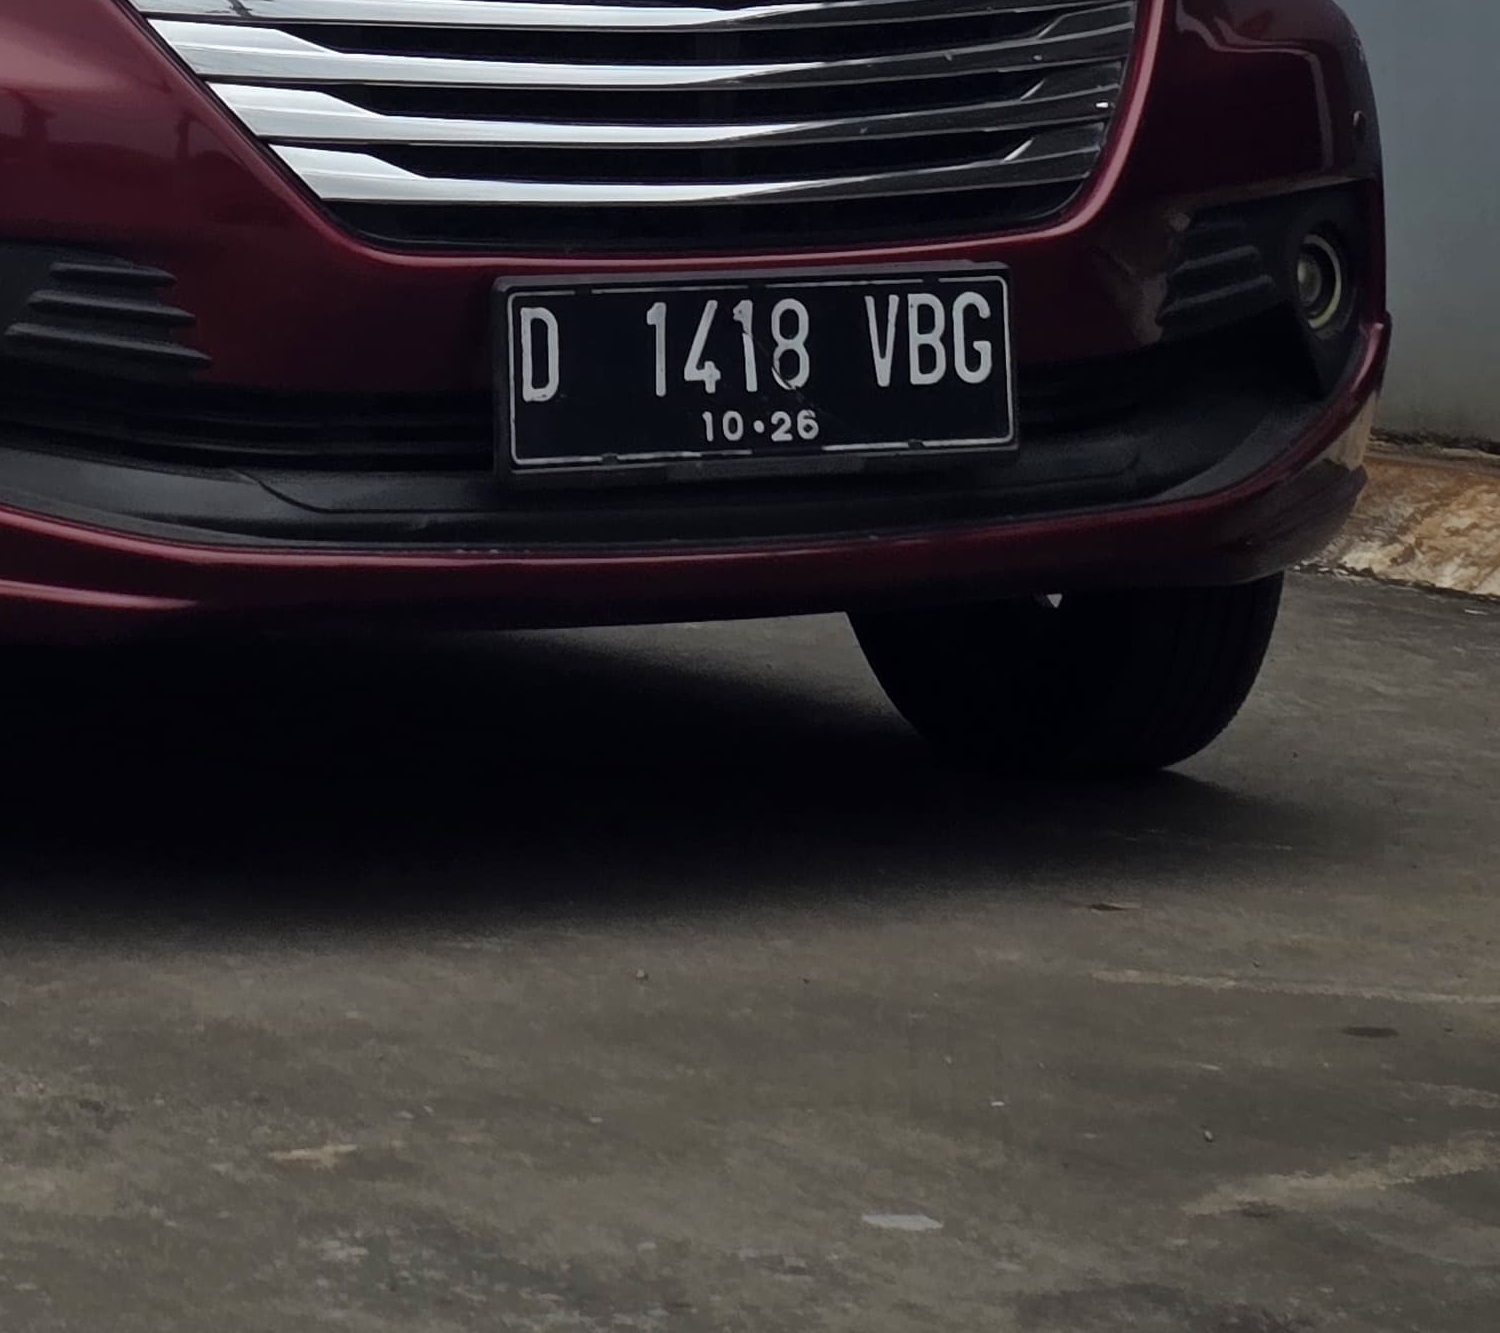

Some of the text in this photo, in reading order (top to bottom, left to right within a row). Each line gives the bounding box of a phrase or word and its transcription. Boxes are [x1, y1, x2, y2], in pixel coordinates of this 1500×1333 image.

[520, 291, 993, 402] D 1418 VBG
